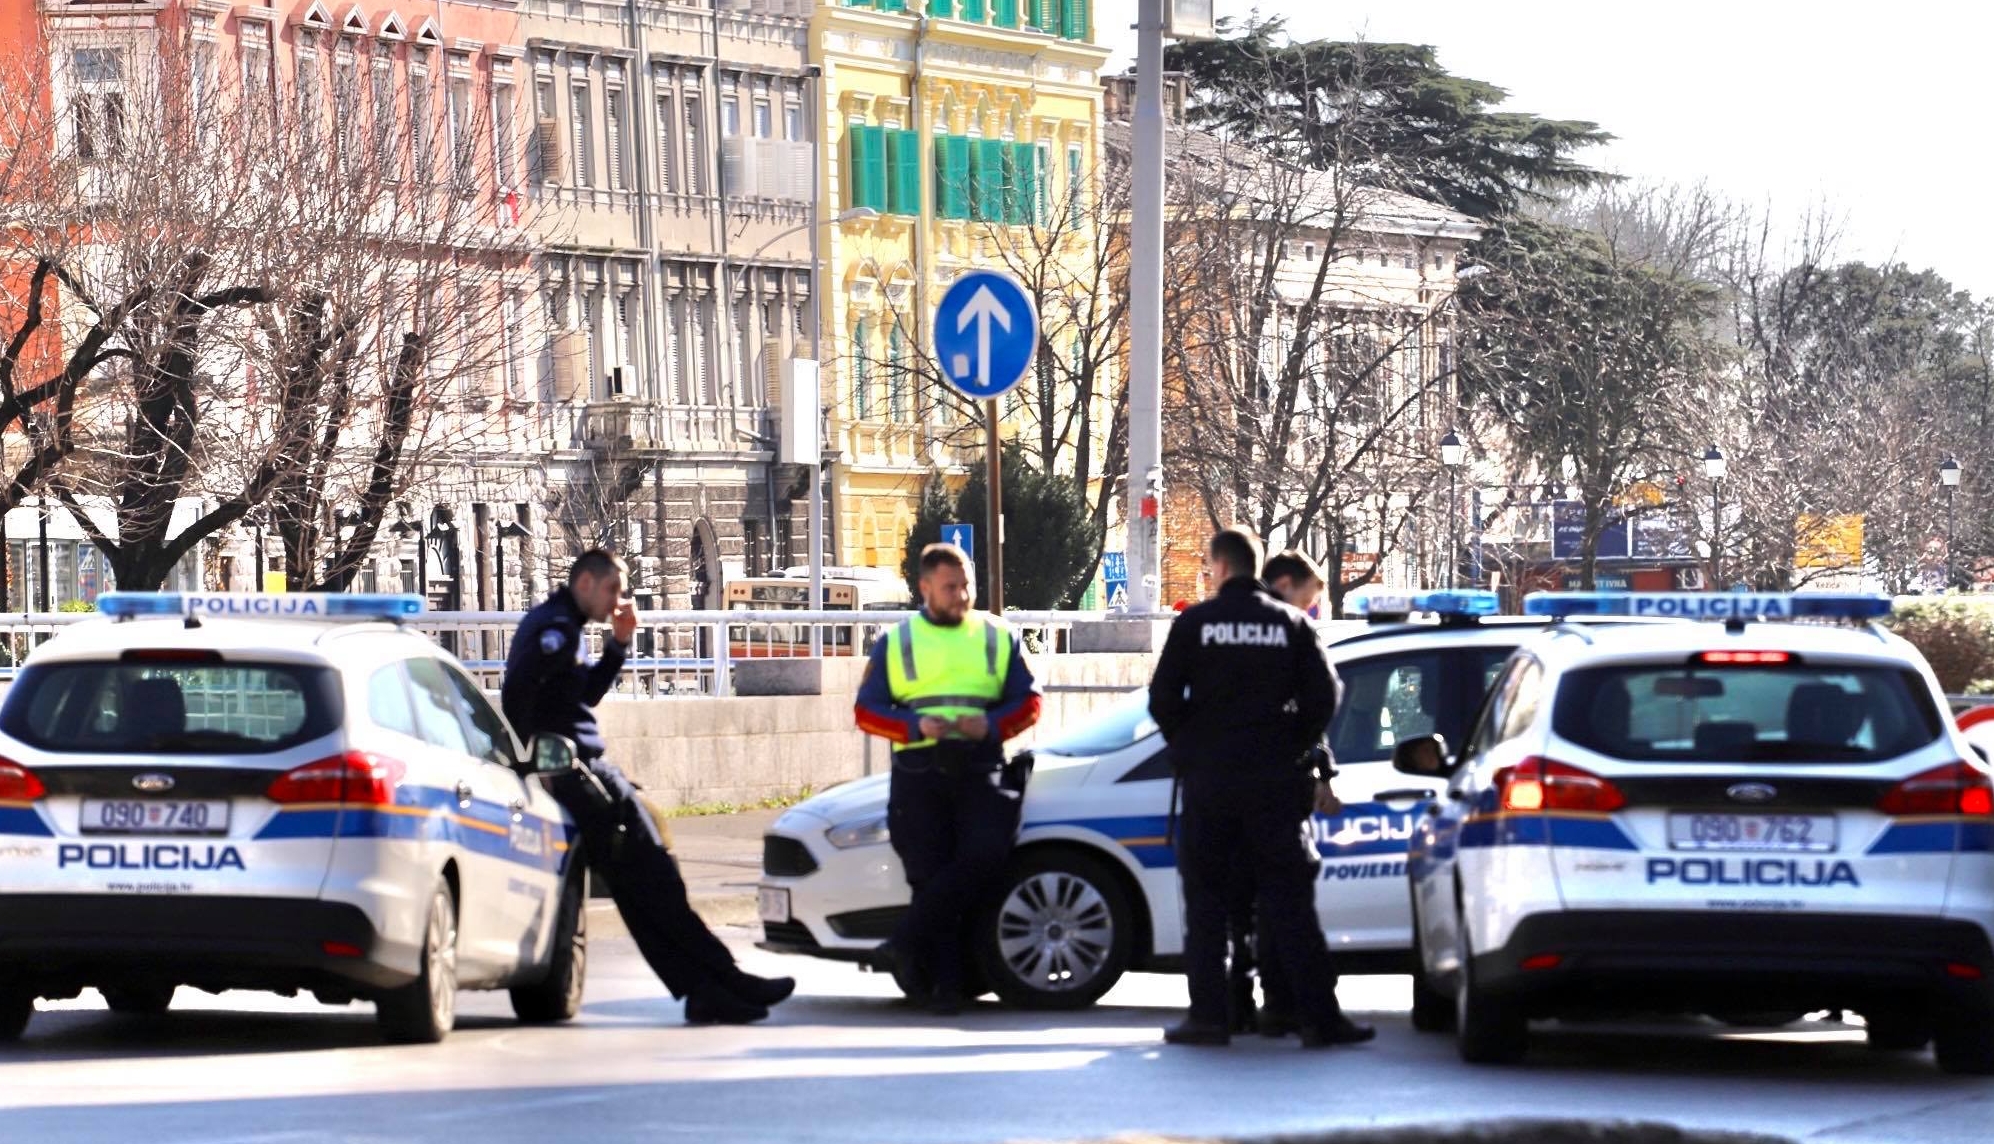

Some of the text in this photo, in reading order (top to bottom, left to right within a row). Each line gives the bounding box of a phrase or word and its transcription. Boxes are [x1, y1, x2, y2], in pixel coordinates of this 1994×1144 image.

[188, 597, 317, 614] POLICIJA
[1637, 597, 1784, 616] POLICIJA
[1201, 622, 1288, 647] POLICIJA
[101, 801, 209, 828] 090 740
[1690, 815, 1813, 845] 090 762
[58, 844, 246, 871] POLICIJA
[1646, 857, 1860, 888] POLICIJA
